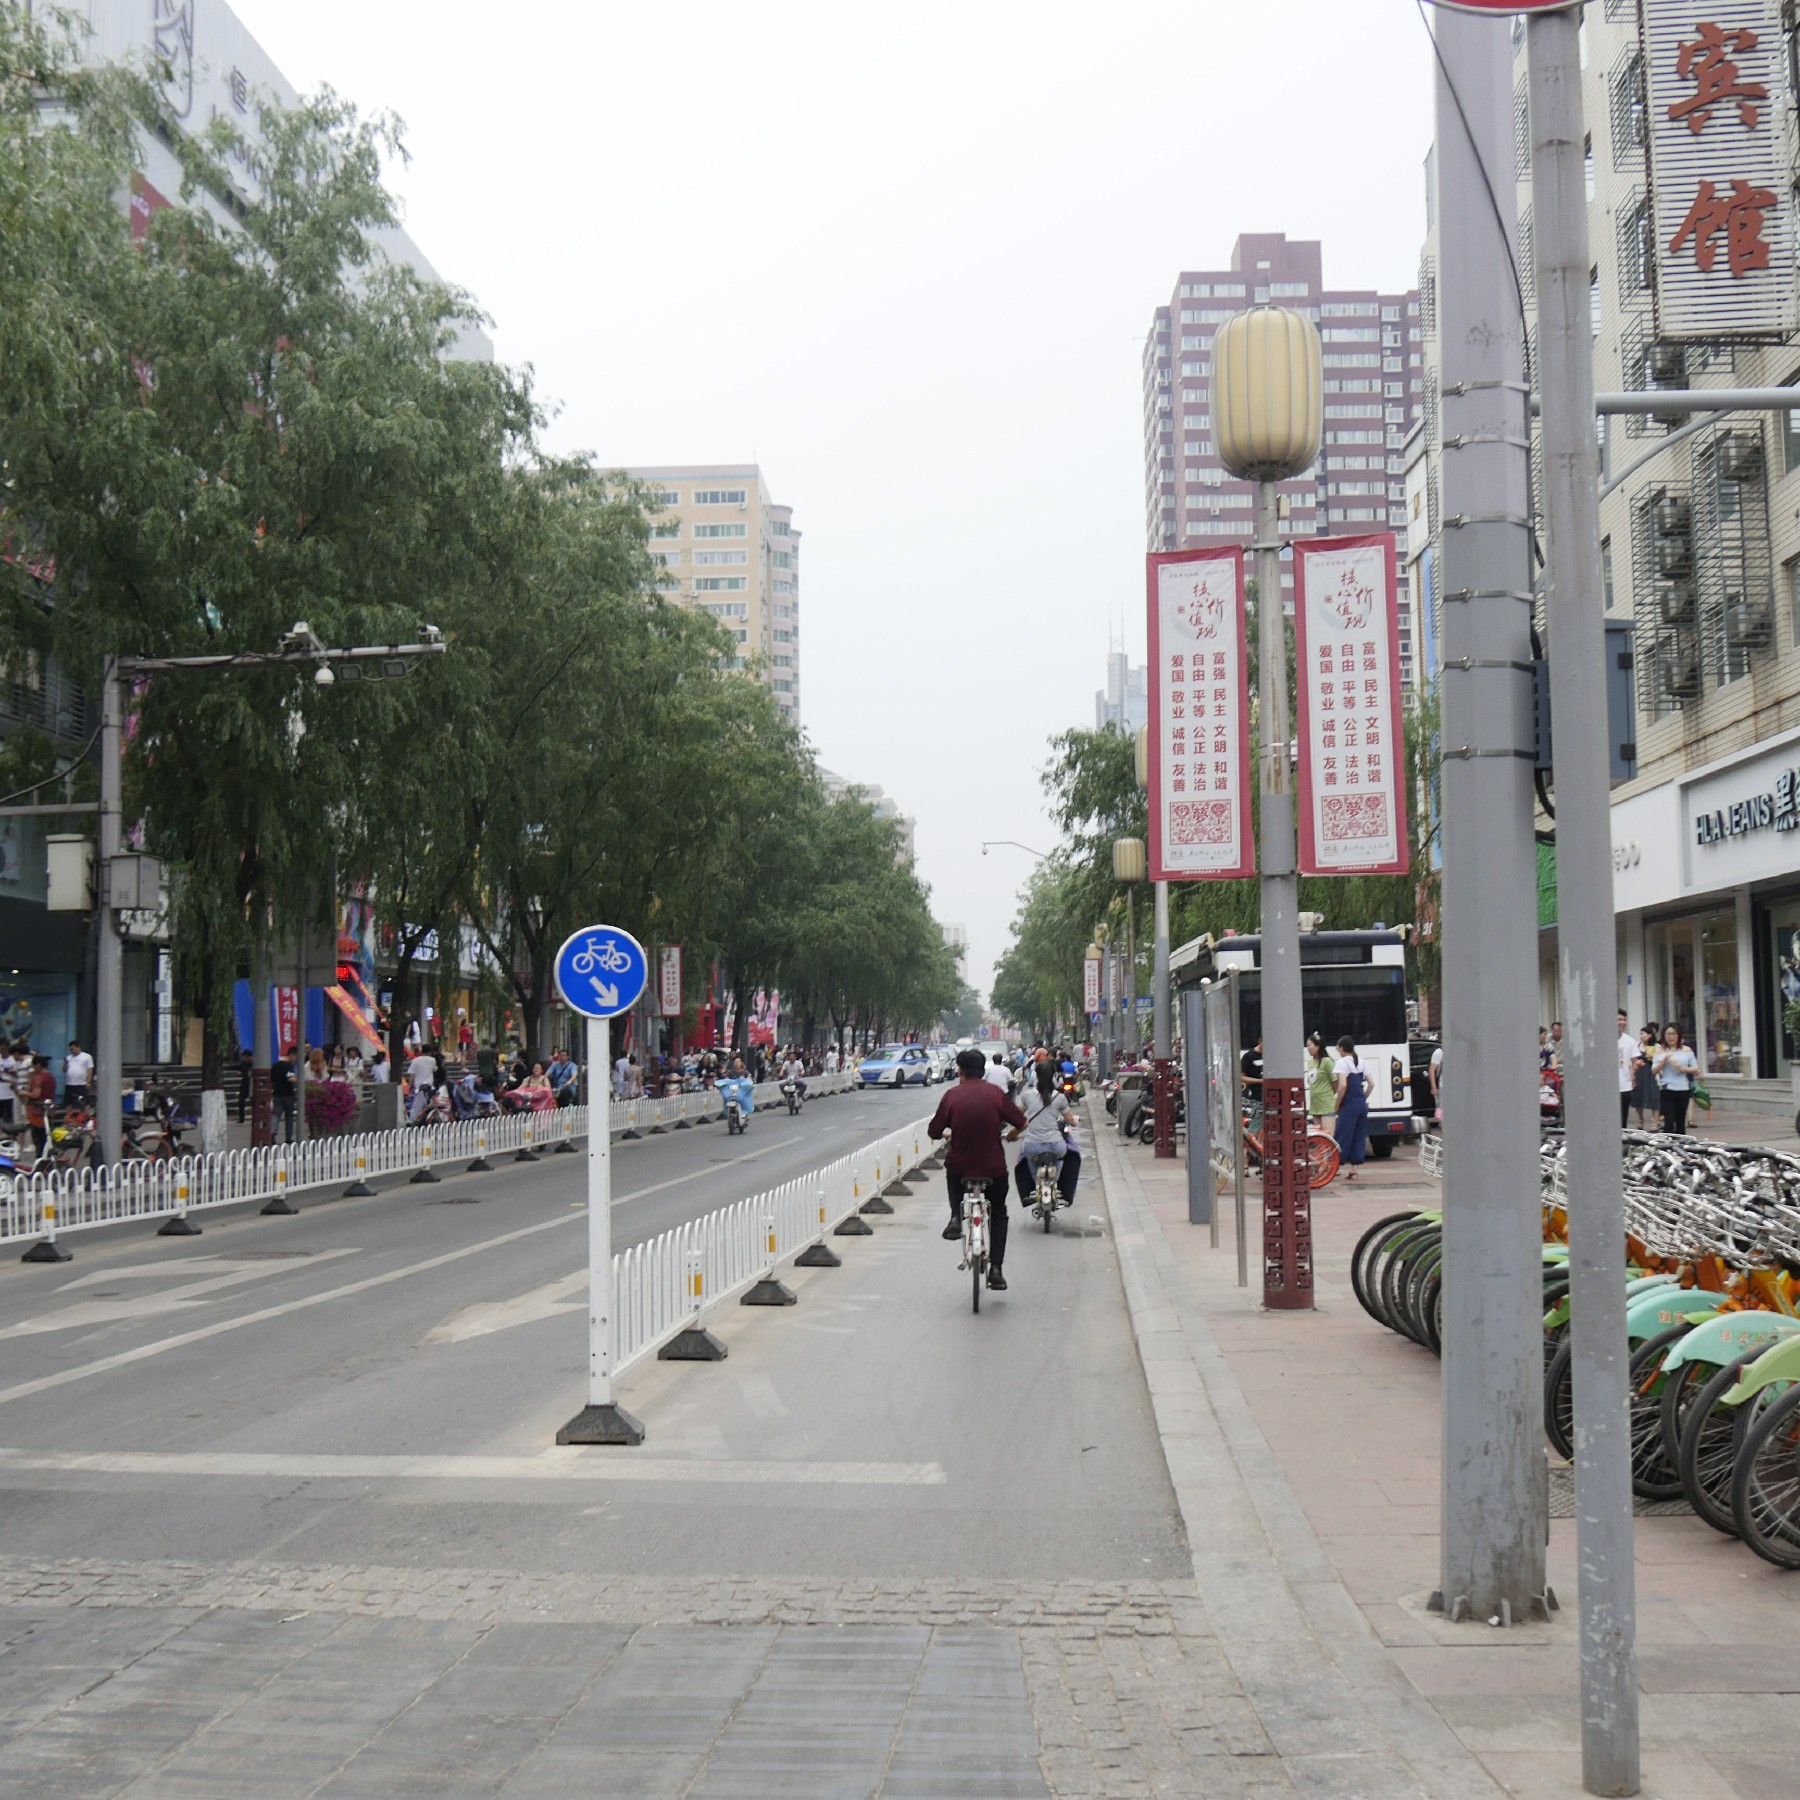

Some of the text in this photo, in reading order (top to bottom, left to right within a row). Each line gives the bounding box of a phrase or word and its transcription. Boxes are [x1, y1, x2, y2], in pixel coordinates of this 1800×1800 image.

[1668, 22, 1778, 279] 宾馆
[1695, 793, 1774, 845] HLA JEANS
[1774, 767, 1800, 833] 黑
